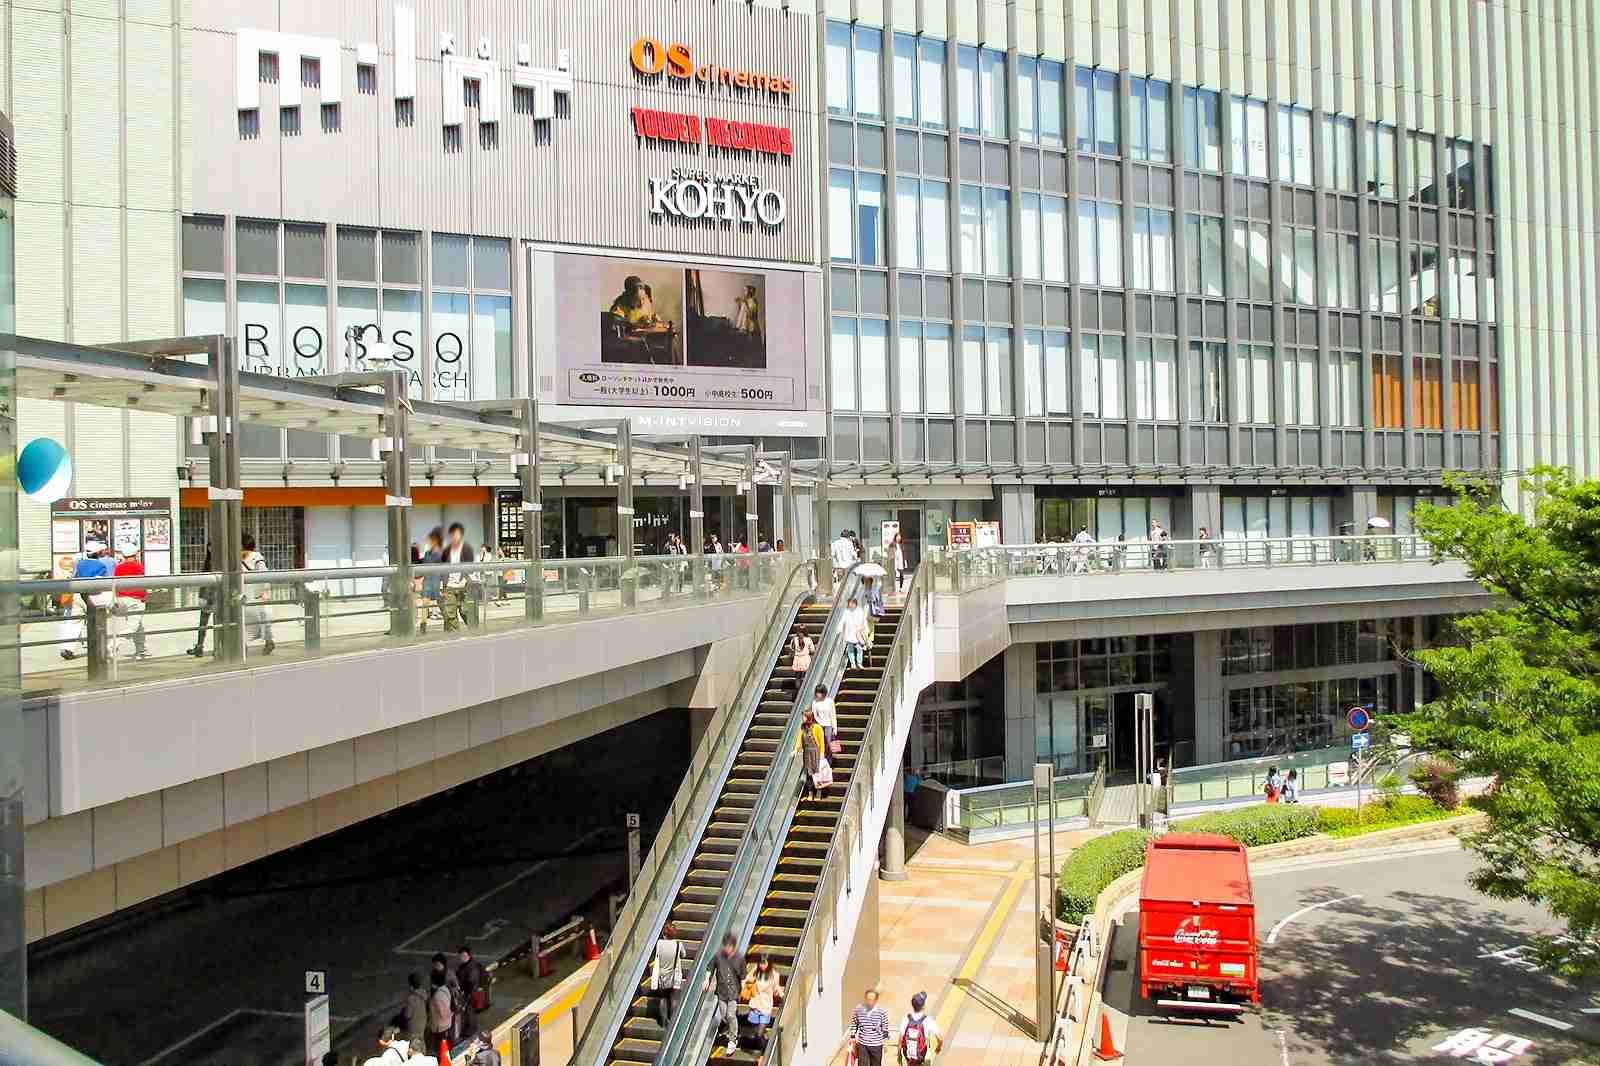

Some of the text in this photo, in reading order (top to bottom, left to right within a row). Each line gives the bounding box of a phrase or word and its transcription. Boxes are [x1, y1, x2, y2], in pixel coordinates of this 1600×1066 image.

[630, 37, 793, 93] OS cinemas
[631, 107, 794, 155] TOWER RECORDS
[673, 167, 763, 187] SUPER MARKET
[649, 176, 786, 225] KOHYO
[653, 385, 696, 398] 1000円
[741, 388, 774, 400] 500円
[69, 499, 88, 510] OS
[89, 500, 127, 508] cinemas
[630, 815, 637, 826] 5
[310, 975, 320, 990] 4
